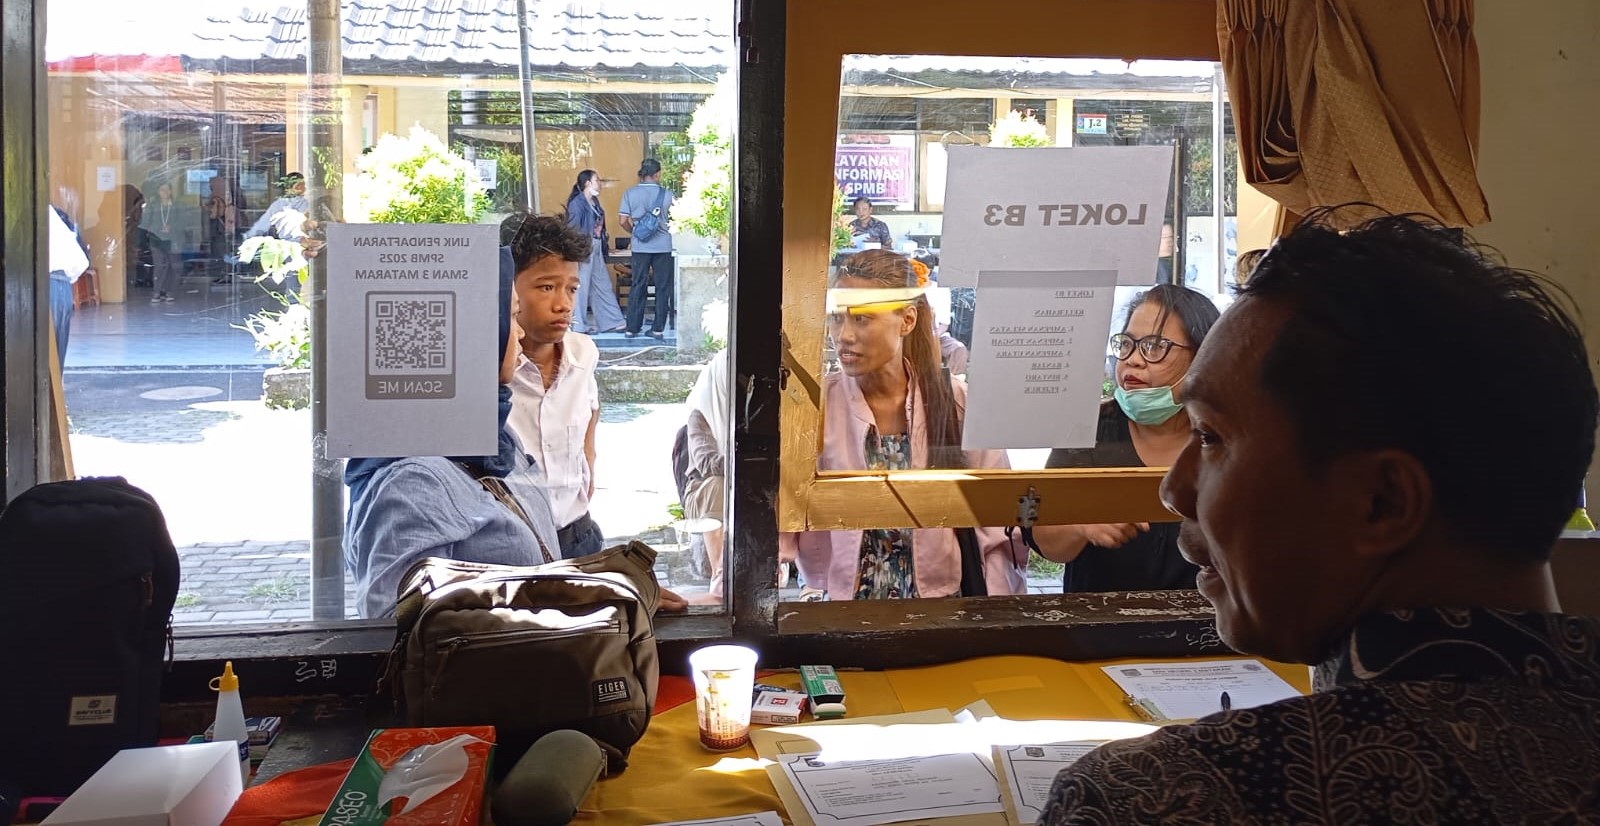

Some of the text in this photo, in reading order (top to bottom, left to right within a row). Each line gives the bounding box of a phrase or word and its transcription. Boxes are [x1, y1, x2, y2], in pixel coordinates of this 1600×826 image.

[1089, 119, 1102, 128] J.2
[835, 168, 904, 180] NFORMASI
[847, 183, 885, 194] SPMB
[598, 681, 625, 694] EIGER
